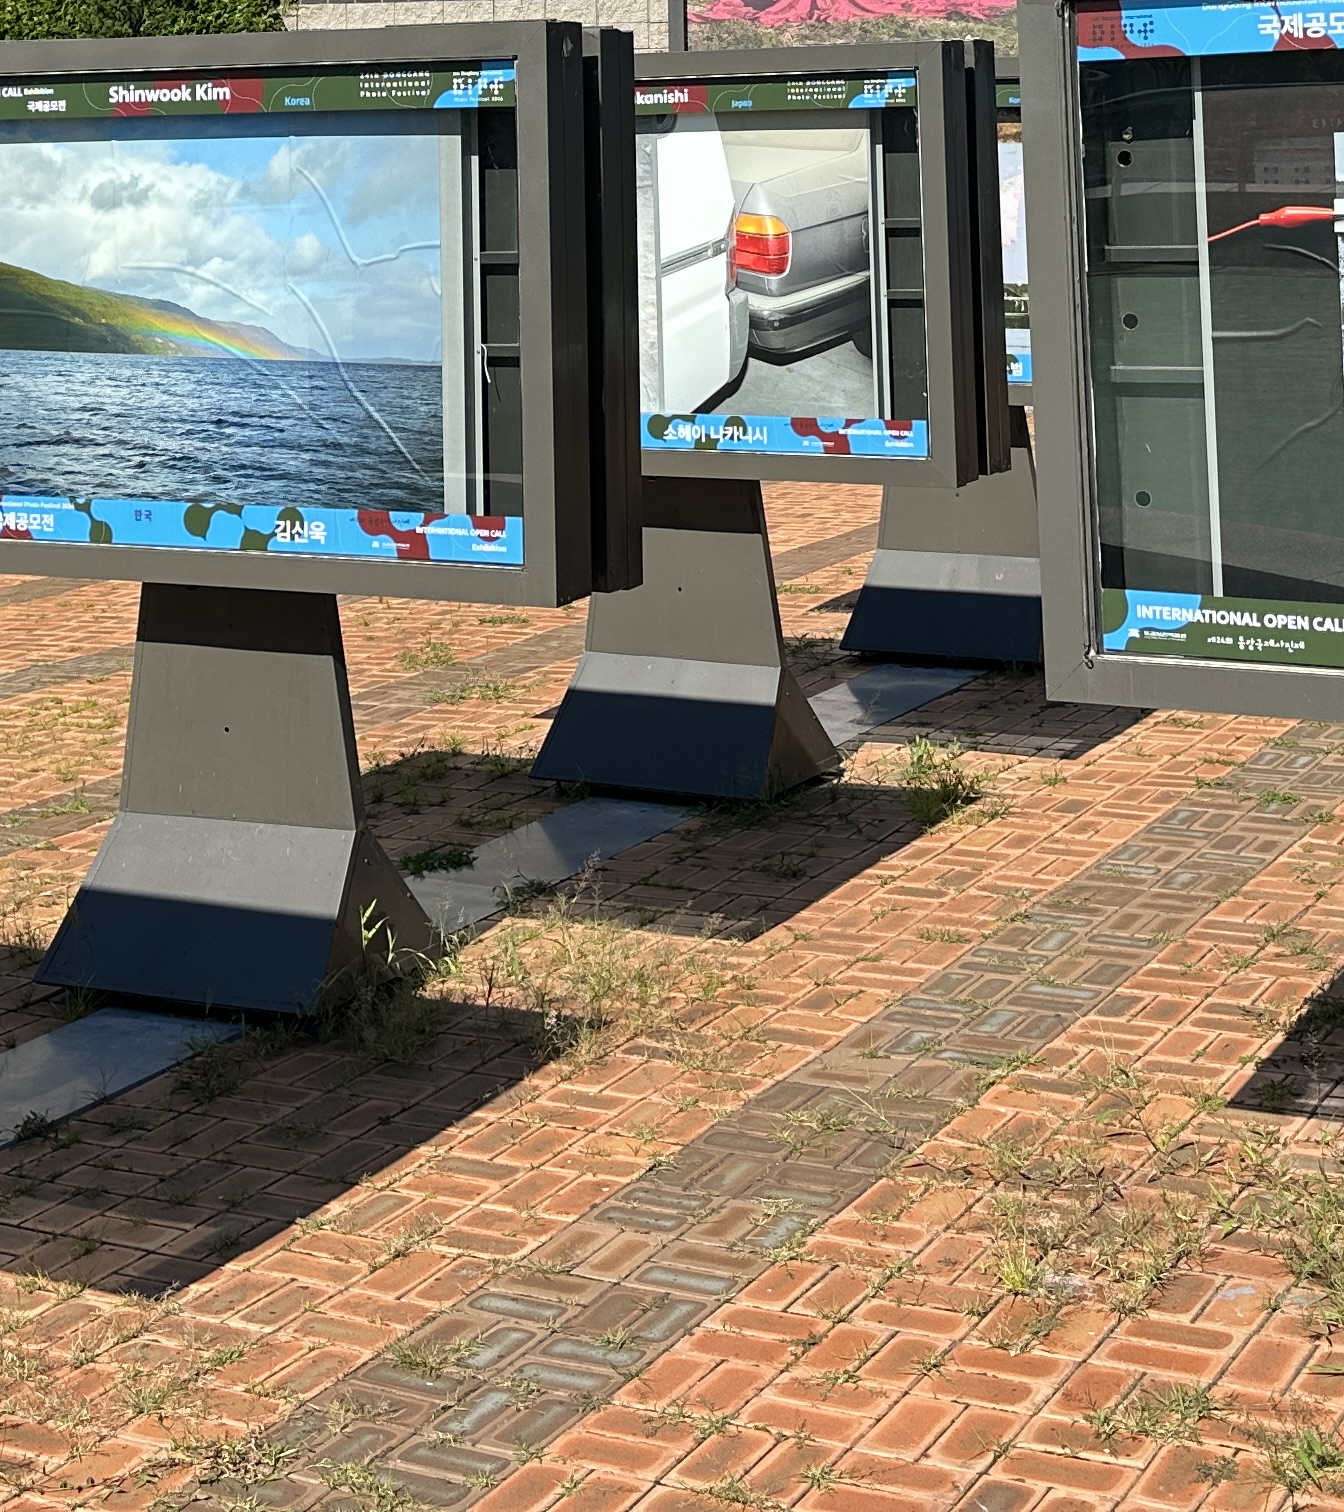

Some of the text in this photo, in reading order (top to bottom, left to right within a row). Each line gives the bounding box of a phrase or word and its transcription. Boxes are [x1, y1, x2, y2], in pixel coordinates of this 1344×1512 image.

[2, 87, 23, 97] CALL
[108, 82, 231, 104] Shinwook Kim
[635, 88, 689, 105] kanishi
[284, 96, 311, 107] Korea
[710, 425, 768, 445] 나카니시
[133, 509, 152, 522] 한국
[274, 519, 328, 545] 김신욱
[415, 526, 508, 538] INTERNATIONAL OPEN CALL
[1136, 604, 1261, 628] INTERNATIONAL
[1263, 613, 1310, 631] OPEN
